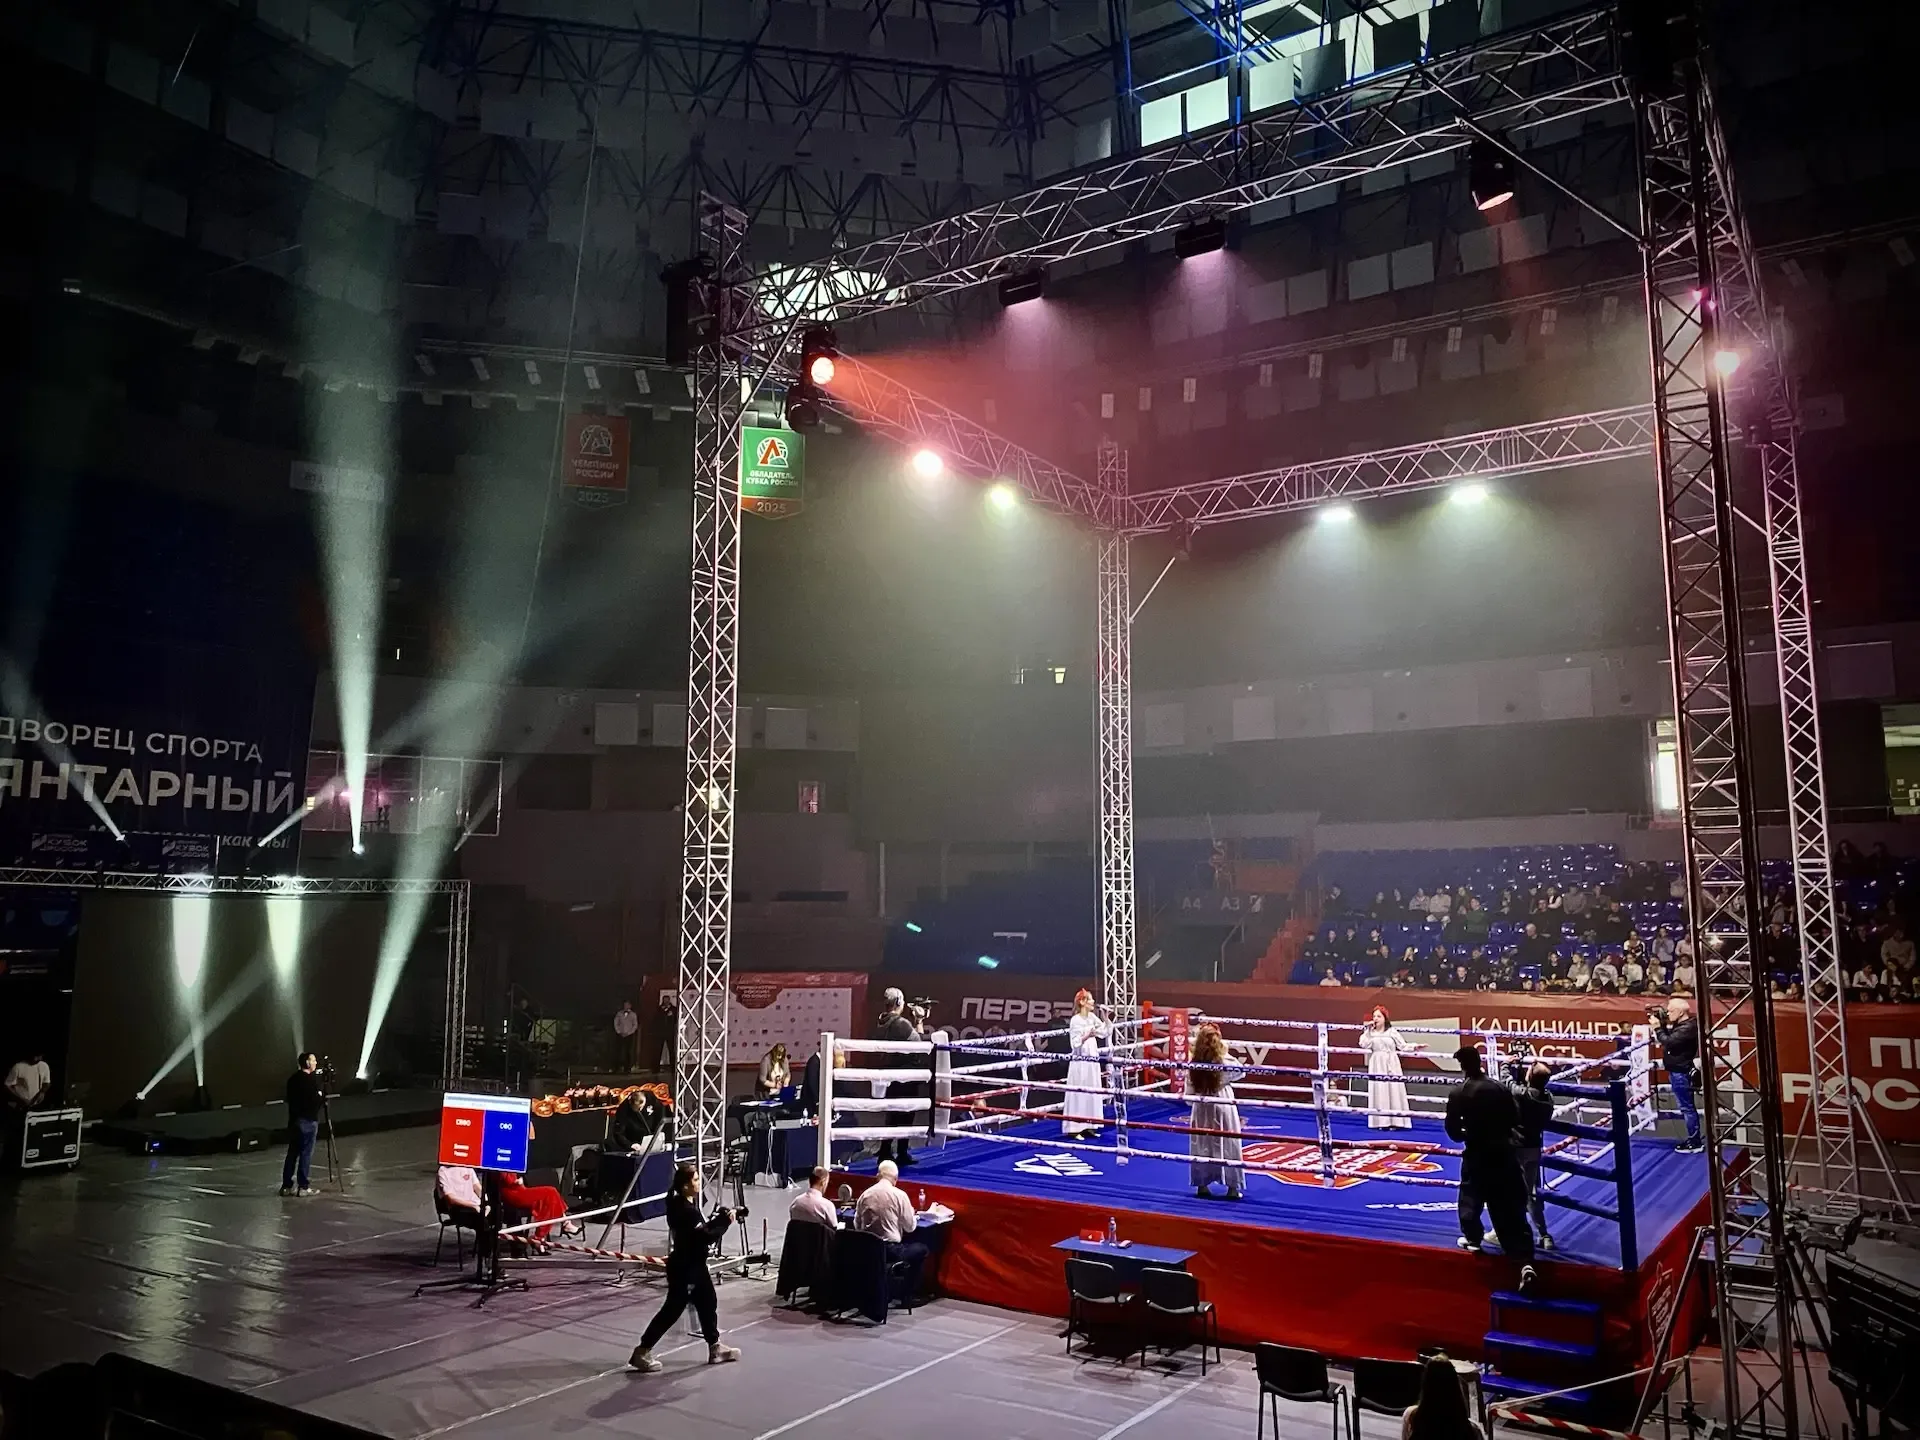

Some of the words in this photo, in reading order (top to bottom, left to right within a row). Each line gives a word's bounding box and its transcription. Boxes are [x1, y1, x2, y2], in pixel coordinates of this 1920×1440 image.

[571, 459, 620, 470] ЧЕМПИОН
[576, 468, 616, 479] РОССИИ
[749, 470, 796, 480] ОБЛАДАТЕЛЬ
[745, 477, 770, 486] КУБКА
[770, 478, 799, 488] РОССИИ
[757, 501, 787, 513] 2025
[0, 716, 136, 755] ДВОРЕЦ
[145, 733, 263, 763] СПОРТА
[0, 757, 296, 815] ЯНТАРНЫЙ
[221, 835, 254, 849] как
